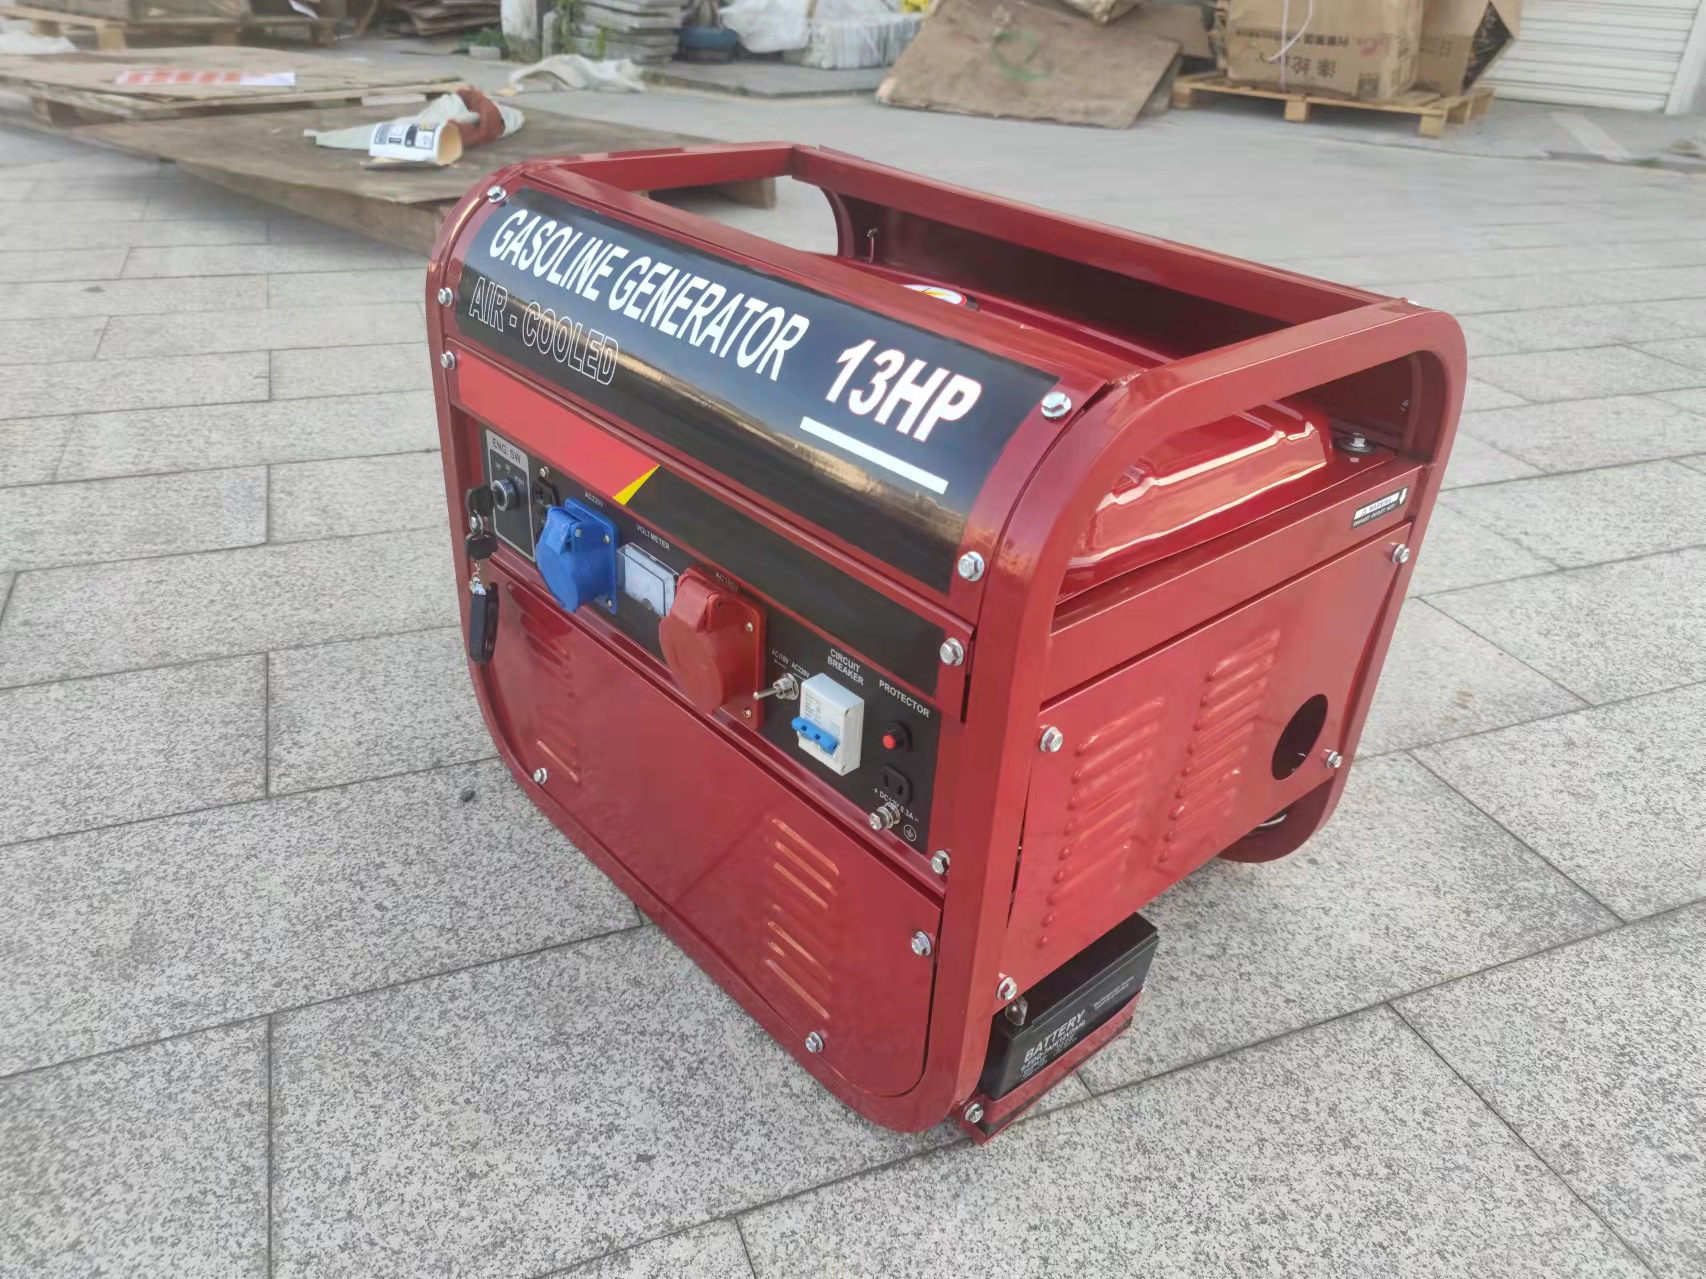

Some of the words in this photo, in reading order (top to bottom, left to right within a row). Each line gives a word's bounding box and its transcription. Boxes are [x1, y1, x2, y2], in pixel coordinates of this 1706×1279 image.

[468, 277, 508, 332] AIR
[522, 301, 619, 386] COOLED
[489, 209, 630, 301] GASOLINE
[608, 256, 810, 381] GENERATOR
[825, 339, 982, 443] 13HP
[636, 523, 670, 551] VOLTMETER
[827, 655, 864, 686] BREAKER
[830, 648, 861, 673] CIRCUIT
[879, 679, 931, 719] PROTECTOR
[1024, 1008, 1086, 1064] BATTERY
